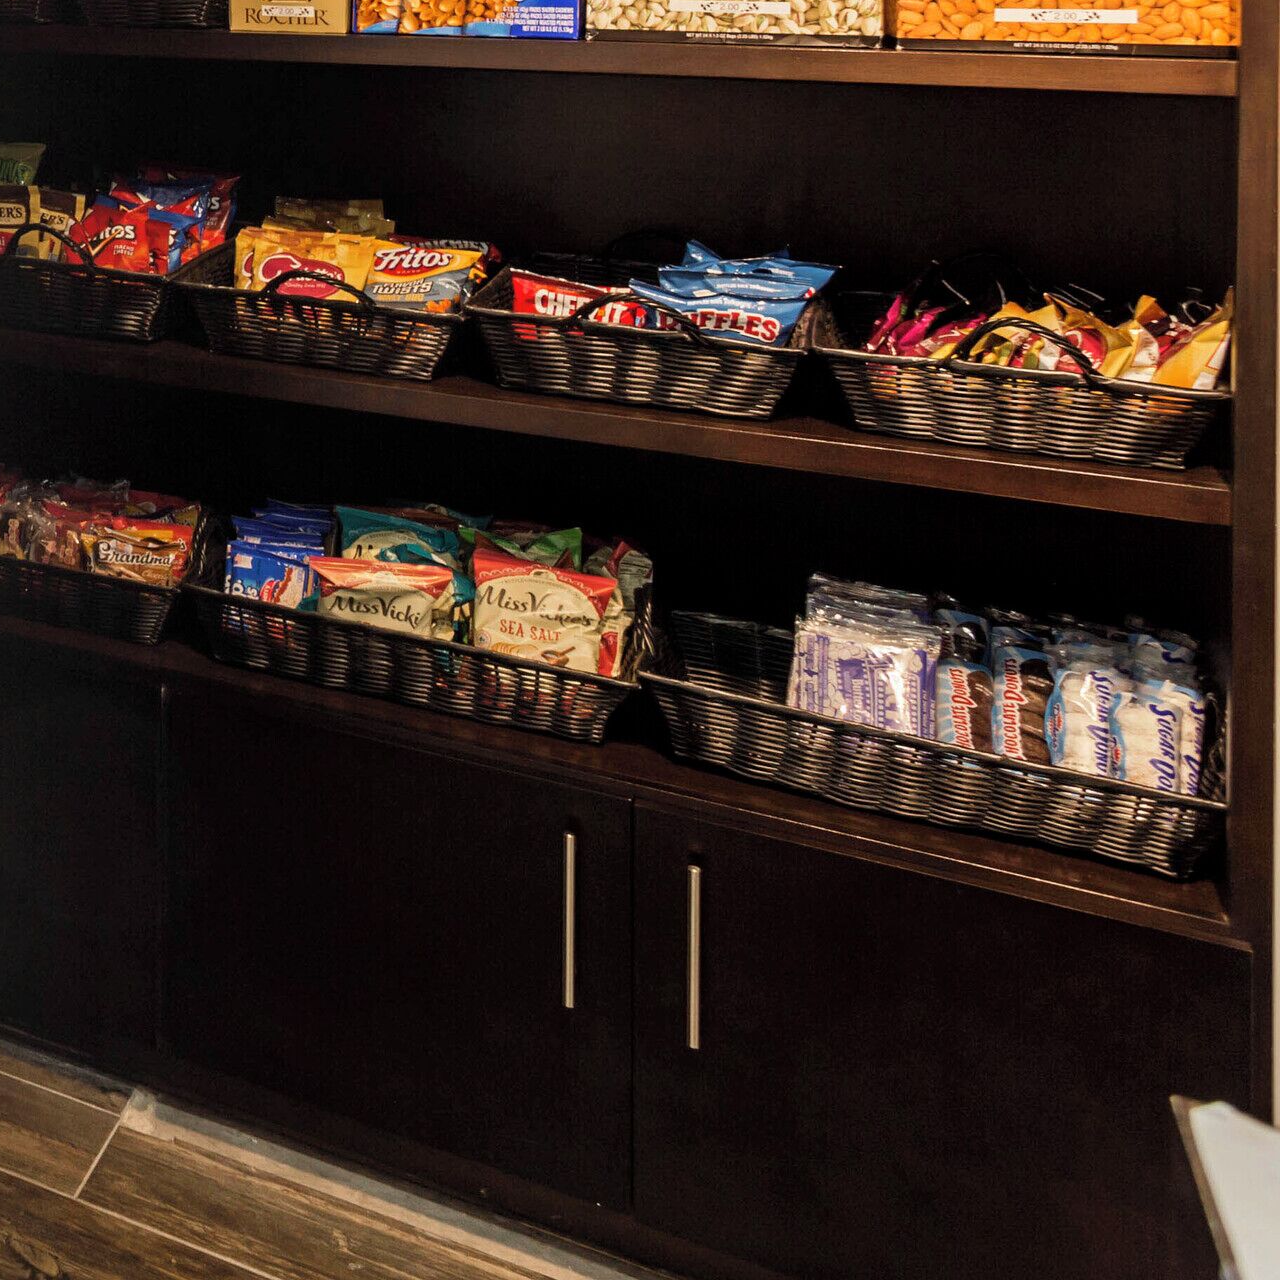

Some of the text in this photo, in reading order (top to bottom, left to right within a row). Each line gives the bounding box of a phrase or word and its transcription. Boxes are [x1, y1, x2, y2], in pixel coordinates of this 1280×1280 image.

[1053, 11, 1078, 21] 2.00
[374, 246, 454, 271] Fritos
[372, 281, 434, 295] TWISTS
[329, 596, 378, 614] Miss
[477, 586, 528, 612] Miss
[500, 619, 562, 641] SEA SALT
[949, 667, 977, 708] DONUTS
[1003, 658, 1029, 704] DONUTS
[1148, 702, 1177, 761] SUGAR
